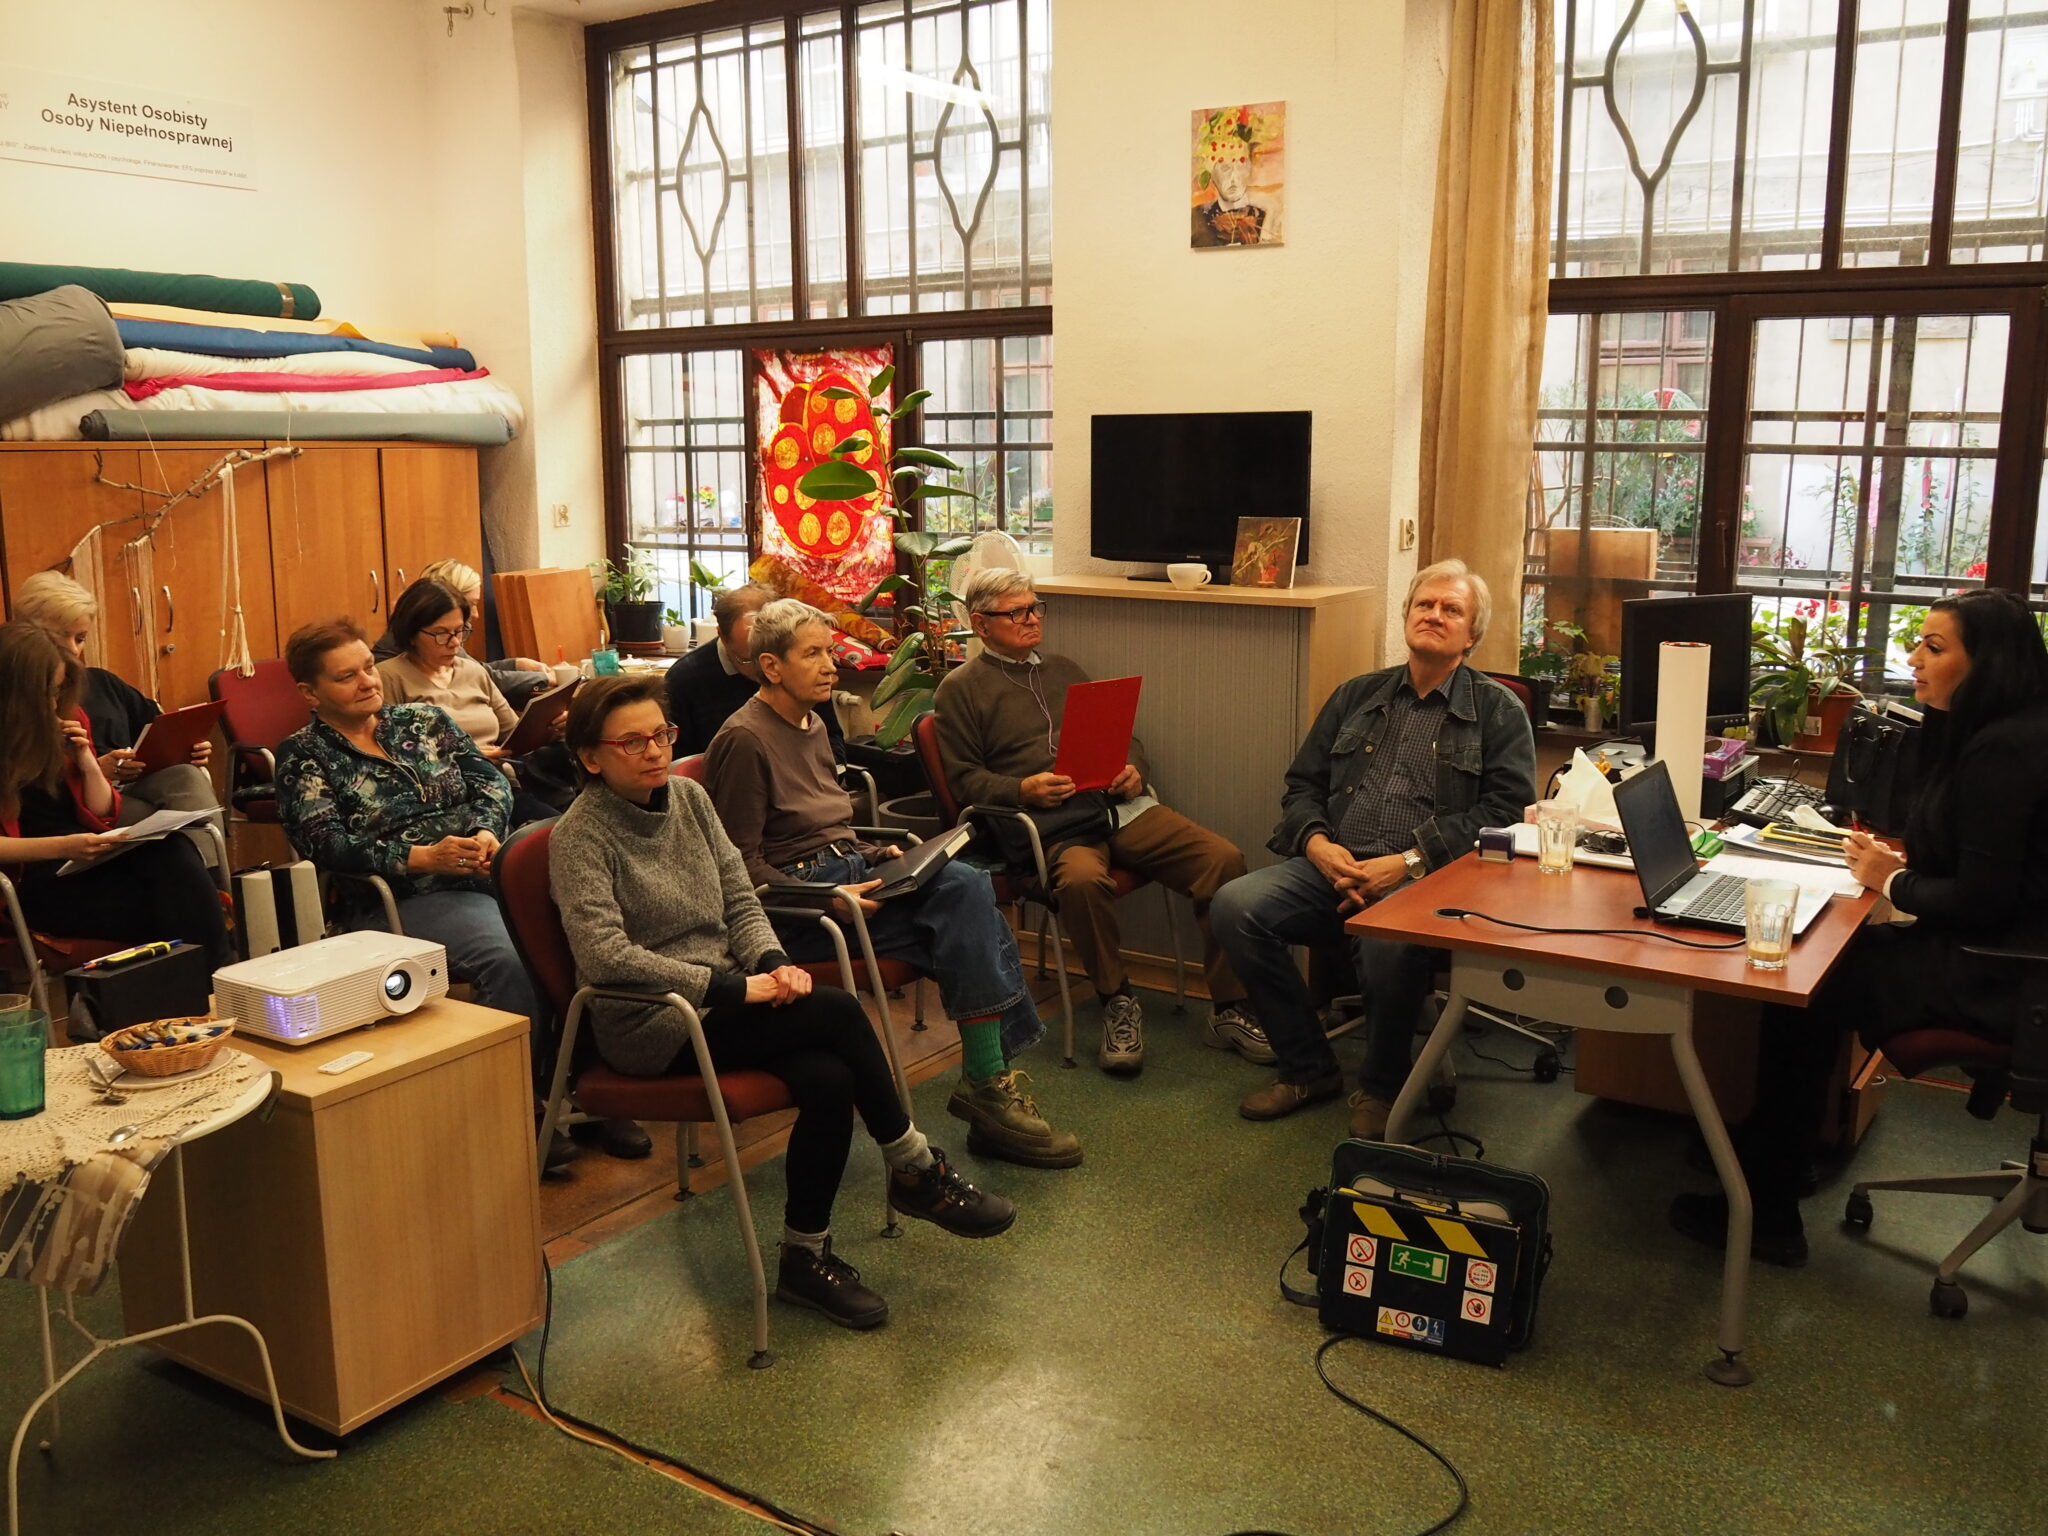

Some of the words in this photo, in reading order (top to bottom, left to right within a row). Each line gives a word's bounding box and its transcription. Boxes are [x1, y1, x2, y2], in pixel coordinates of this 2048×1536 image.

[41, 108, 94, 132] Osoby
[99, 117, 233, 153] Niepełnosprawnej
[67, 92, 138, 117] Asystent
[141, 104, 207, 130] Osobisty
